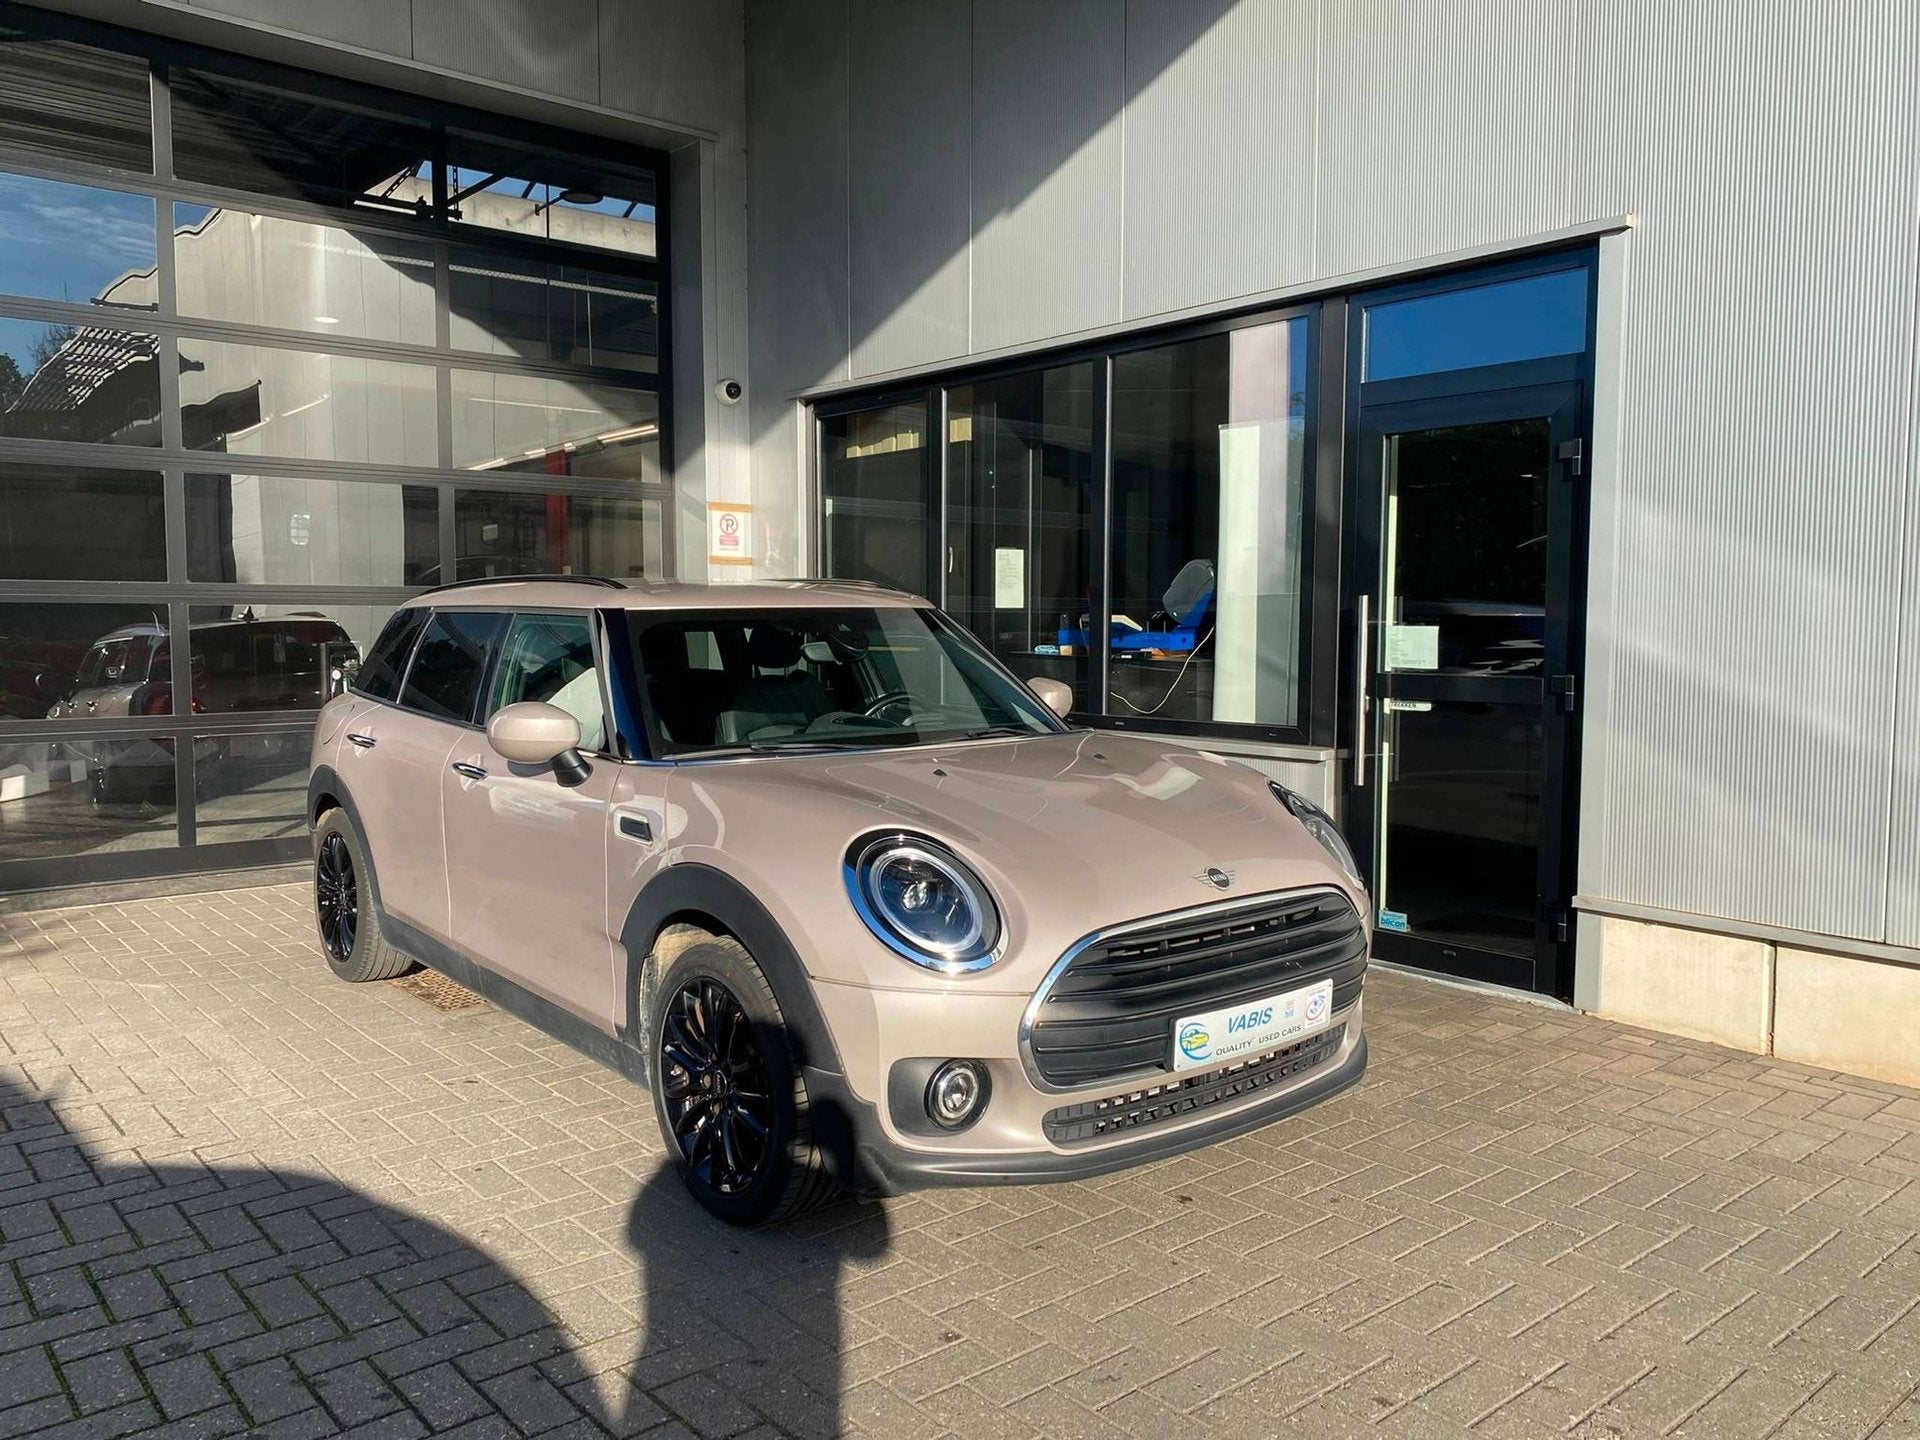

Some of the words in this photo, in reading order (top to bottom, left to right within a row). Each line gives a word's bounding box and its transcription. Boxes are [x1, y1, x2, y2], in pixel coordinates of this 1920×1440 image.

[1228, 1007, 1273, 1033] VABIS
[1215, 1040, 1252, 1056] QUALITY
[1259, 1031, 1280, 1044] USED
[1281, 1024, 1302, 1037] CARS
